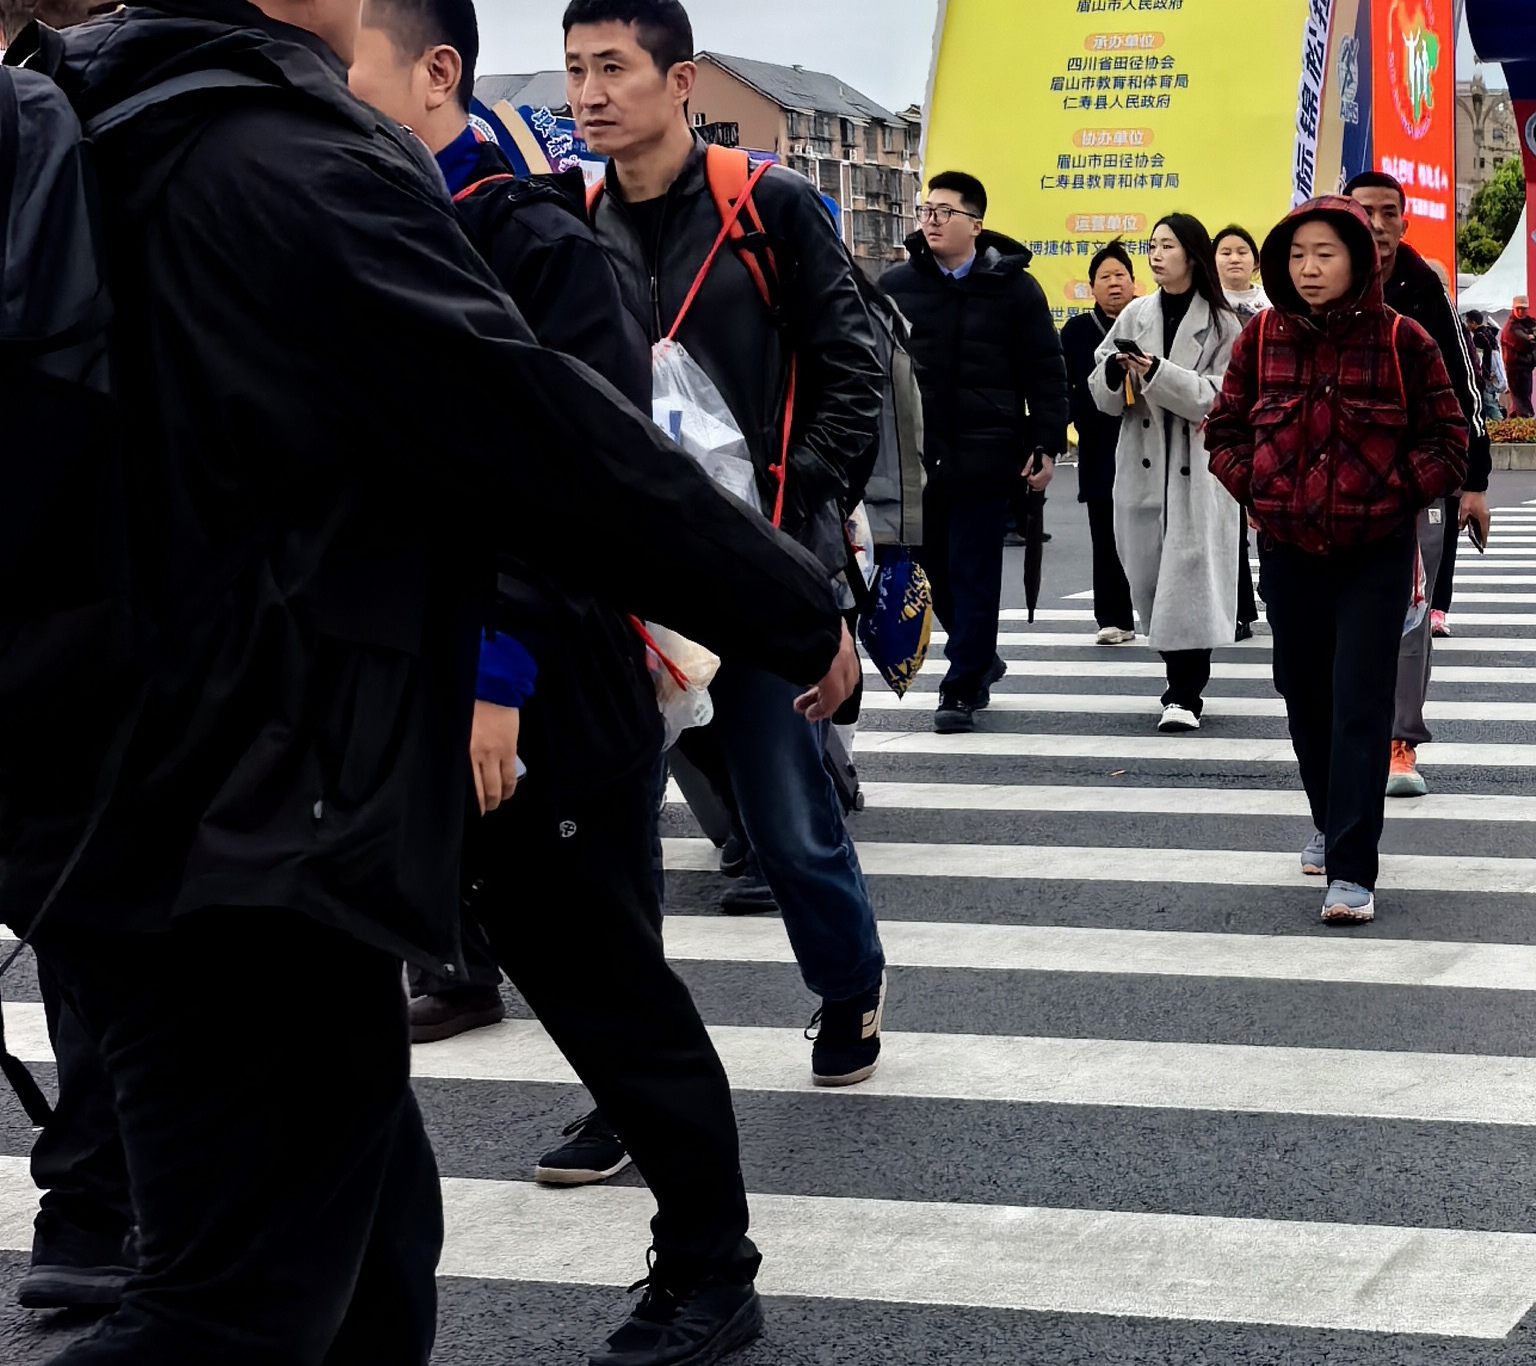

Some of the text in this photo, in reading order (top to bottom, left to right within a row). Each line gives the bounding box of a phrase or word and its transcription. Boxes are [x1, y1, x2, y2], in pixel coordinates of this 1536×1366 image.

[1067, 55, 1175, 71] 四川省田径协会
[1050, 74, 1189, 92] 眉山市教育和体育局
[1063, 94, 1171, 110] 仁寿县人民政府
[1056, 153, 1165, 170] 眉山市田径协会
[1040, 173, 1179, 190] 仁寿县教育和体育局
